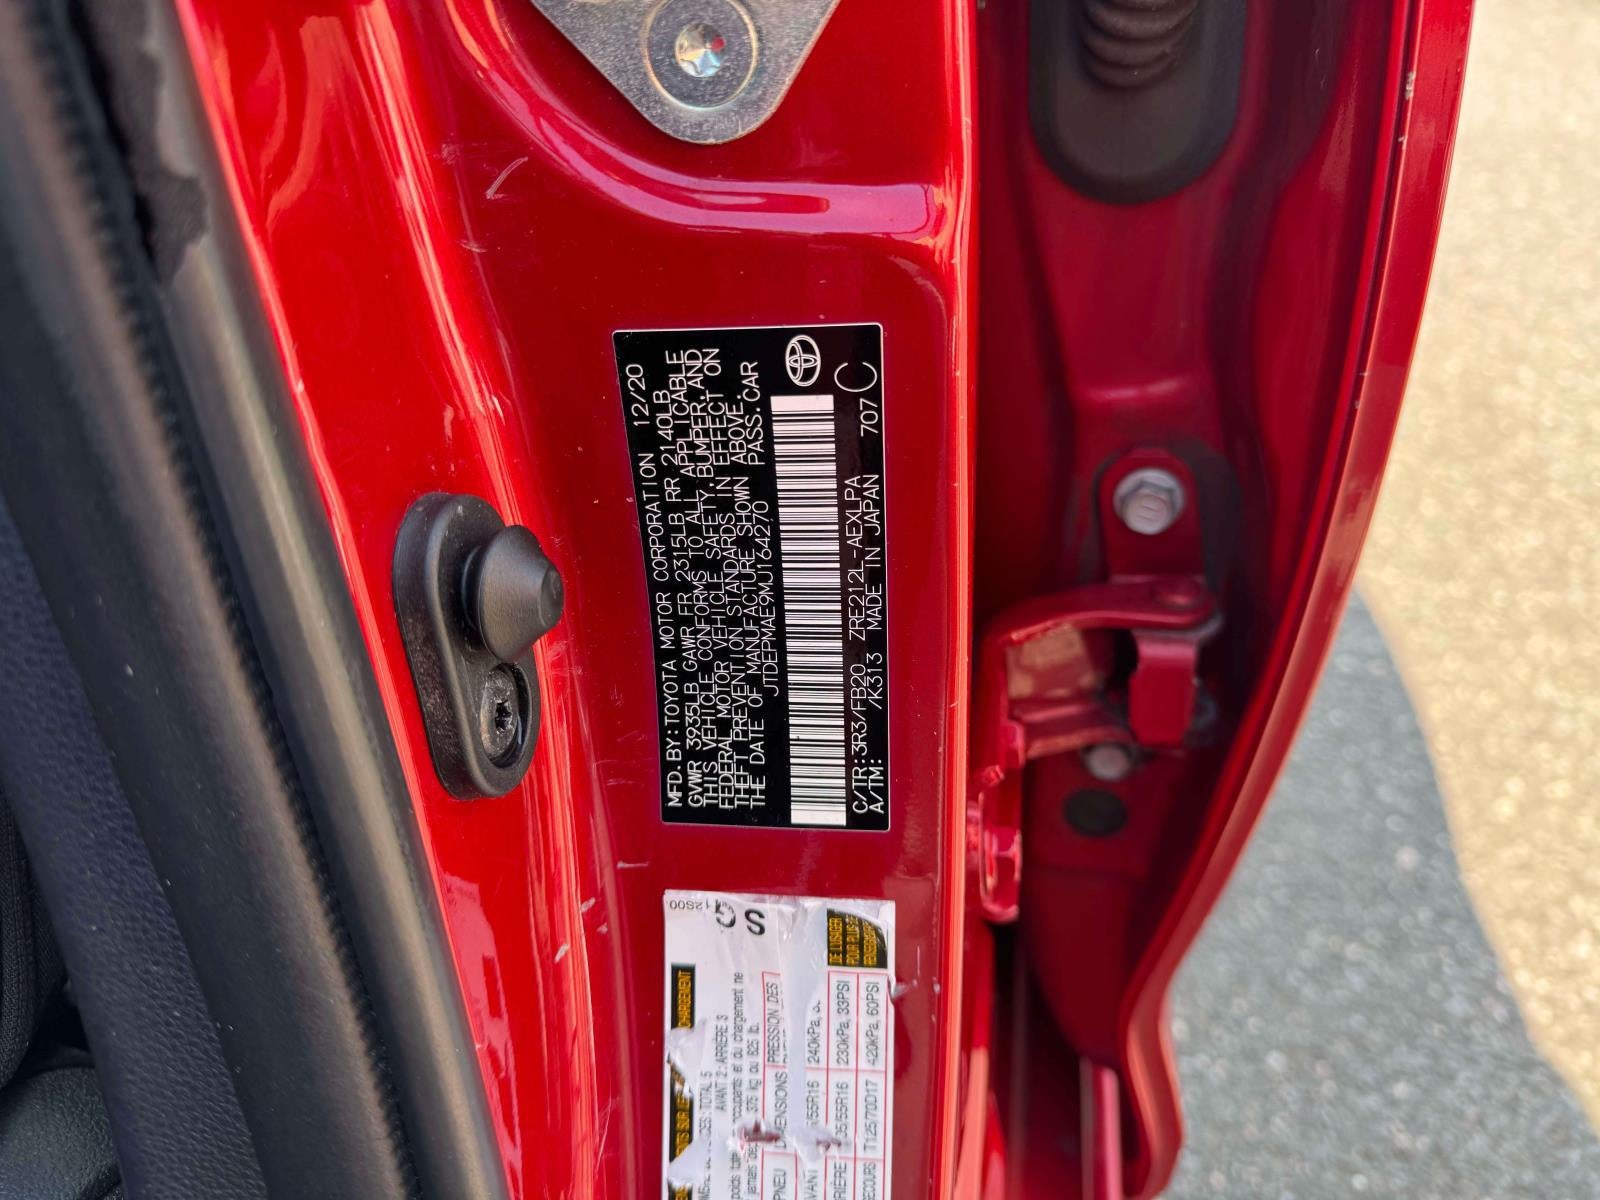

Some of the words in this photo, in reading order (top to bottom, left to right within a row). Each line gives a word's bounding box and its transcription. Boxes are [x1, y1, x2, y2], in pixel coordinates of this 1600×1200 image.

[703, 348, 721, 376] ON
[834, 362, 877, 392] C
[626, 364, 650, 426] 12/20
[665, 350, 696, 477] APPLICABLE
[860, 398, 878, 436] 707
[653, 390, 678, 466] 2140LB
[706, 390, 731, 465] EFFECT
[726, 395, 747, 464] ABOVE.
[664, 478, 681, 501] RR
[684, 490, 702, 524] ALL
[716, 477, 732, 496] IN
[733, 476, 753, 536] SHOWN
[863, 475, 880, 535] JAPAN
[638, 453, 669, 581] CORPORATION
[668, 513, 691, 581] 2315LB
[688, 537, 705, 558] TO
[719, 513, 742, 616] STANDARDS
[845, 476, 866, 640] ZRE212L-AEXLPA
[866, 548, 881, 566] IN
[657, 592, 675, 648] MOTOR
[678, 594, 693, 614] FR
[692, 571, 713, 660] CONFORMS
[708, 572, 728, 650] VEHICLE
[738, 549, 761, 673] MANUFACTURE
[752, 501, 779, 696] JTDEPMAE9MJ164270
[866, 584, 882, 629] MADE
[680, 627, 697, 671] GAWR
[715, 661, 731, 717] MOTOR
[728, 628, 748, 741] PREVENTION
[747, 686, 763, 707] OF
[867, 652, 882, 710] /K313
[684, 683, 701, 750] 3935LB
[699, 672, 716, 750] VEHICLE
[718, 729, 734, 808] FEDERAL
[748, 719, 765, 764] DATE
[688, 761, 702, 807] GVWR
[703, 762, 718, 807] THIS
[734, 752, 750, 807] THEFT
[749, 776, 765, 807] THE
[869, 759, 883, 814] A/TM:
[766, 982, 779, 1004] DES
[836, 981, 850, 1014] 33PSI
[865, 982, 879, 1016] 60PSI
[768, 1009, 781, 1063] PRESSION
[807, 1016, 821, 1064] 240kPa,
[836, 1019, 850, 1065] 230kPa,
[804, 1169, 818, 1200] VANT
